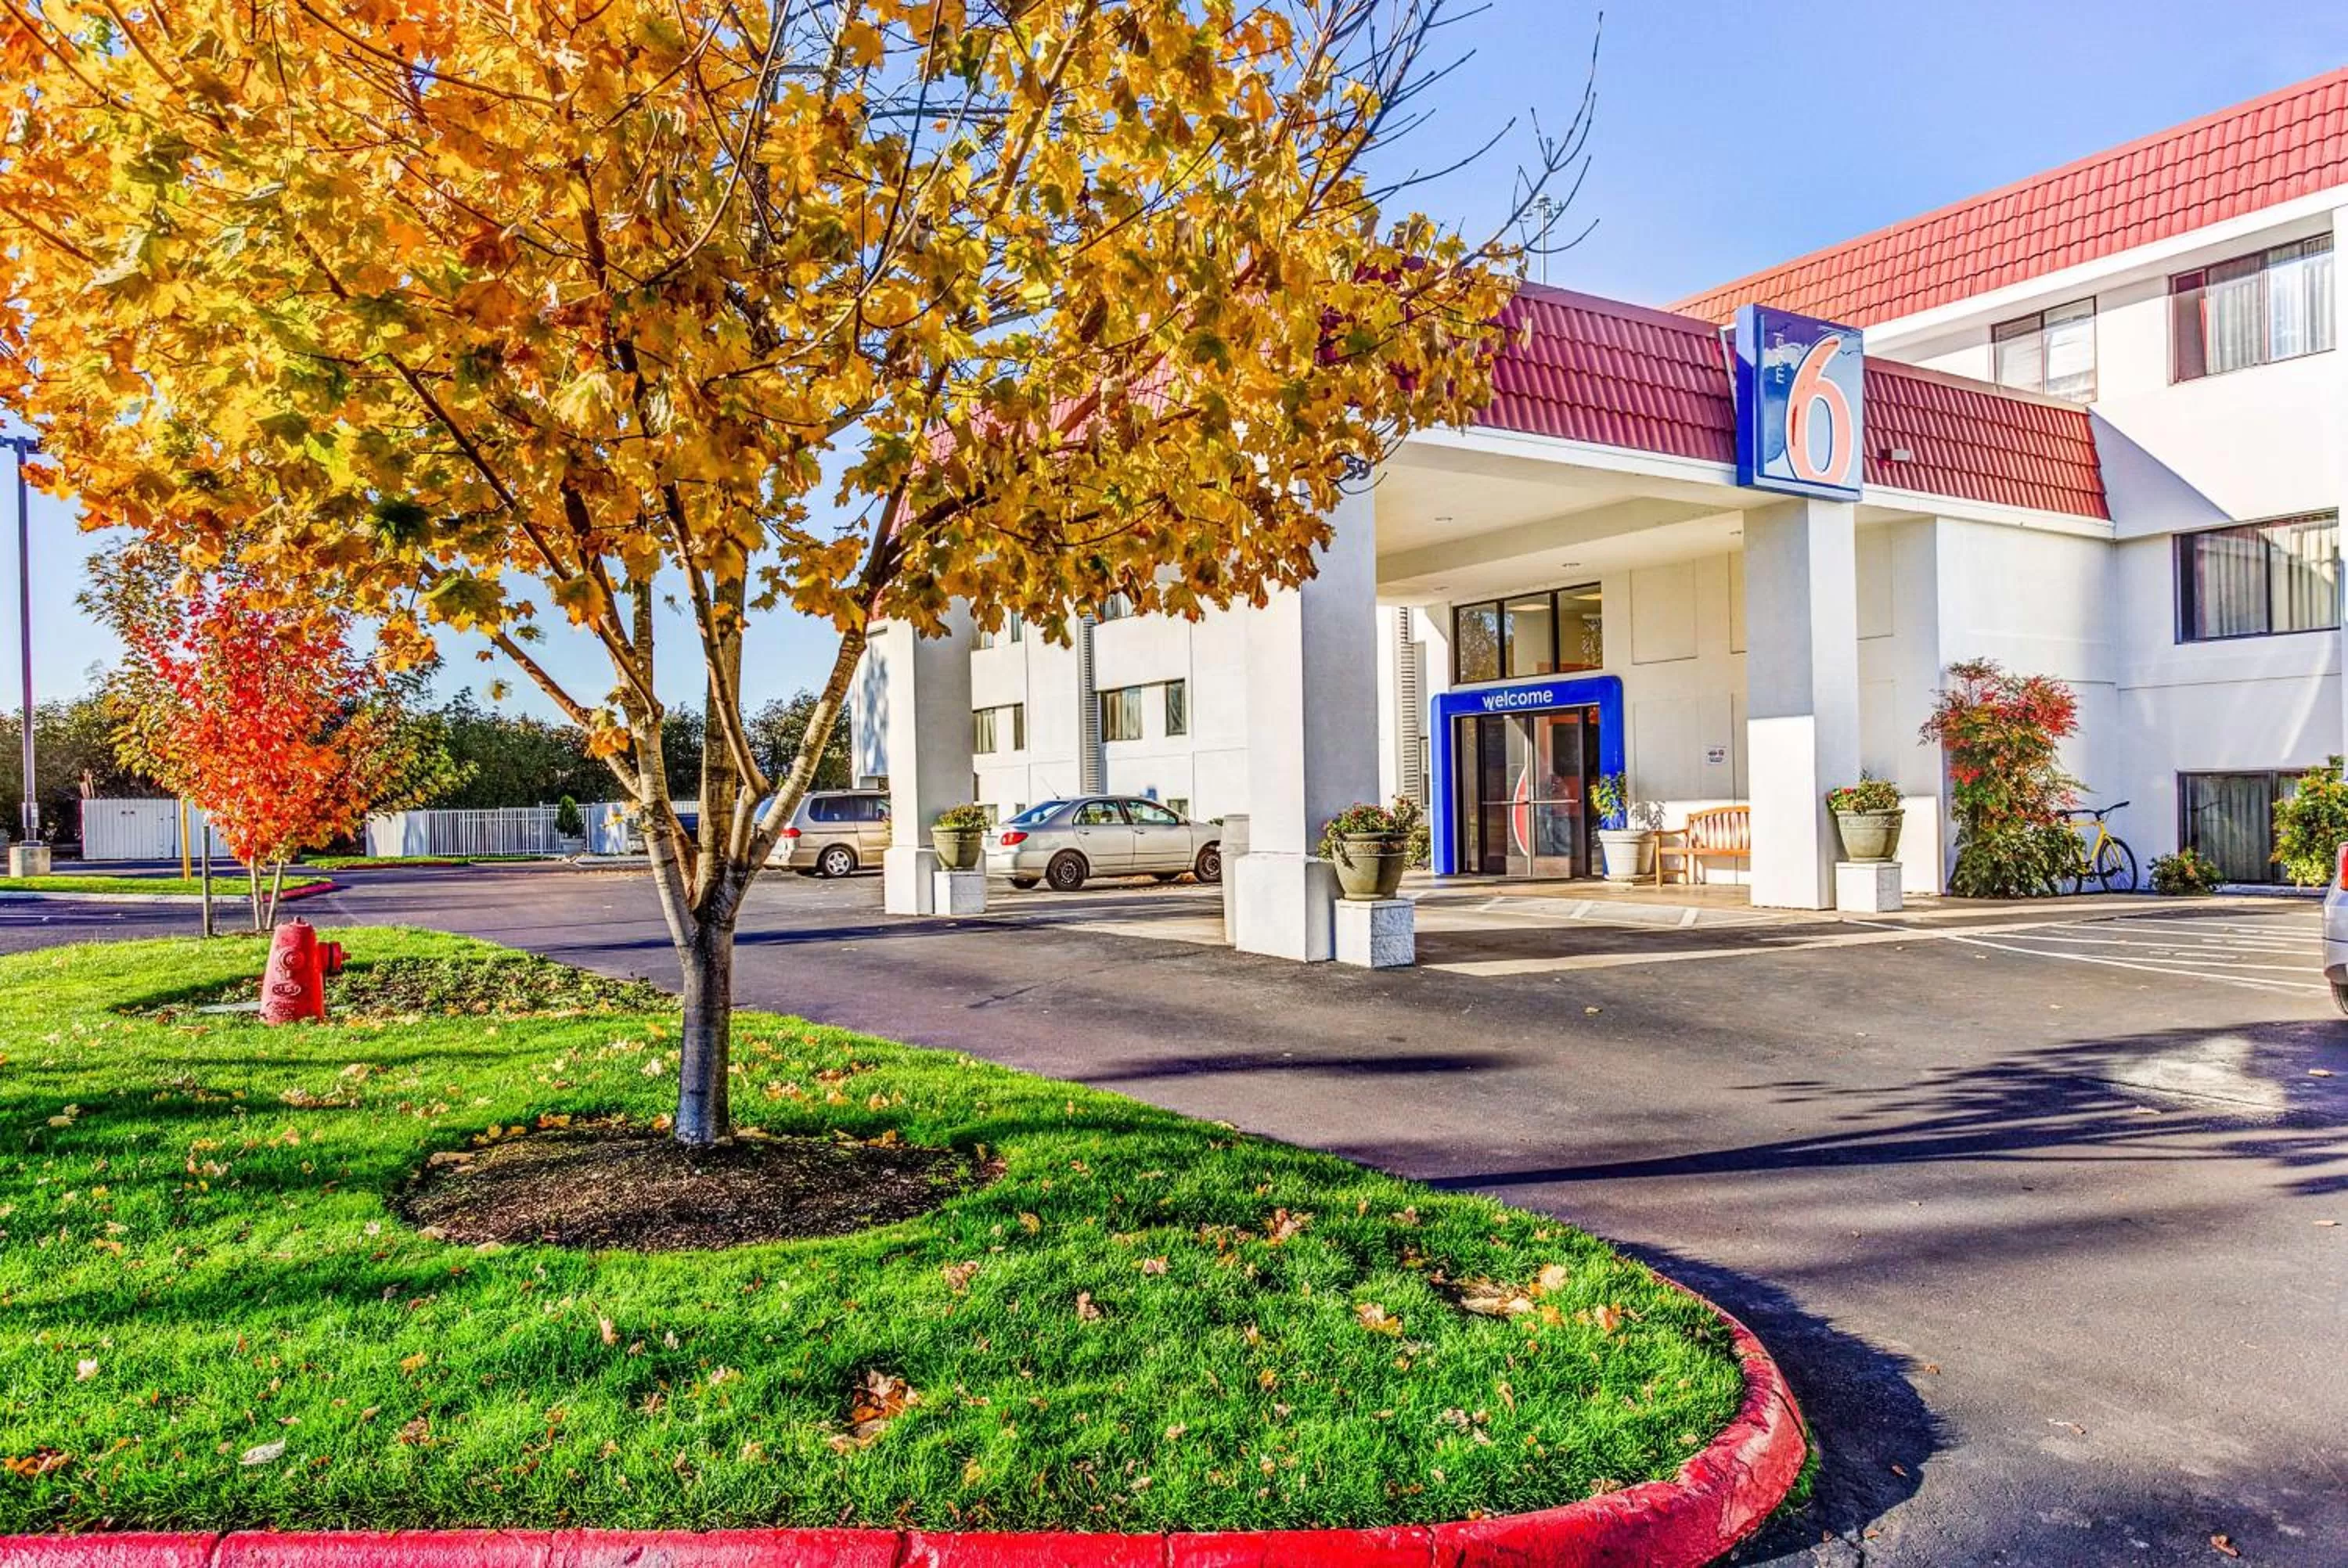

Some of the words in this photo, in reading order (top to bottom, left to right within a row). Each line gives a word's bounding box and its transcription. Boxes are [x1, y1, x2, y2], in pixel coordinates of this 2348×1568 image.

[1773, 332, 1785, 384] moel
[1786, 334, 1854, 484] 6
[1482, 689, 1554, 710] welcome
